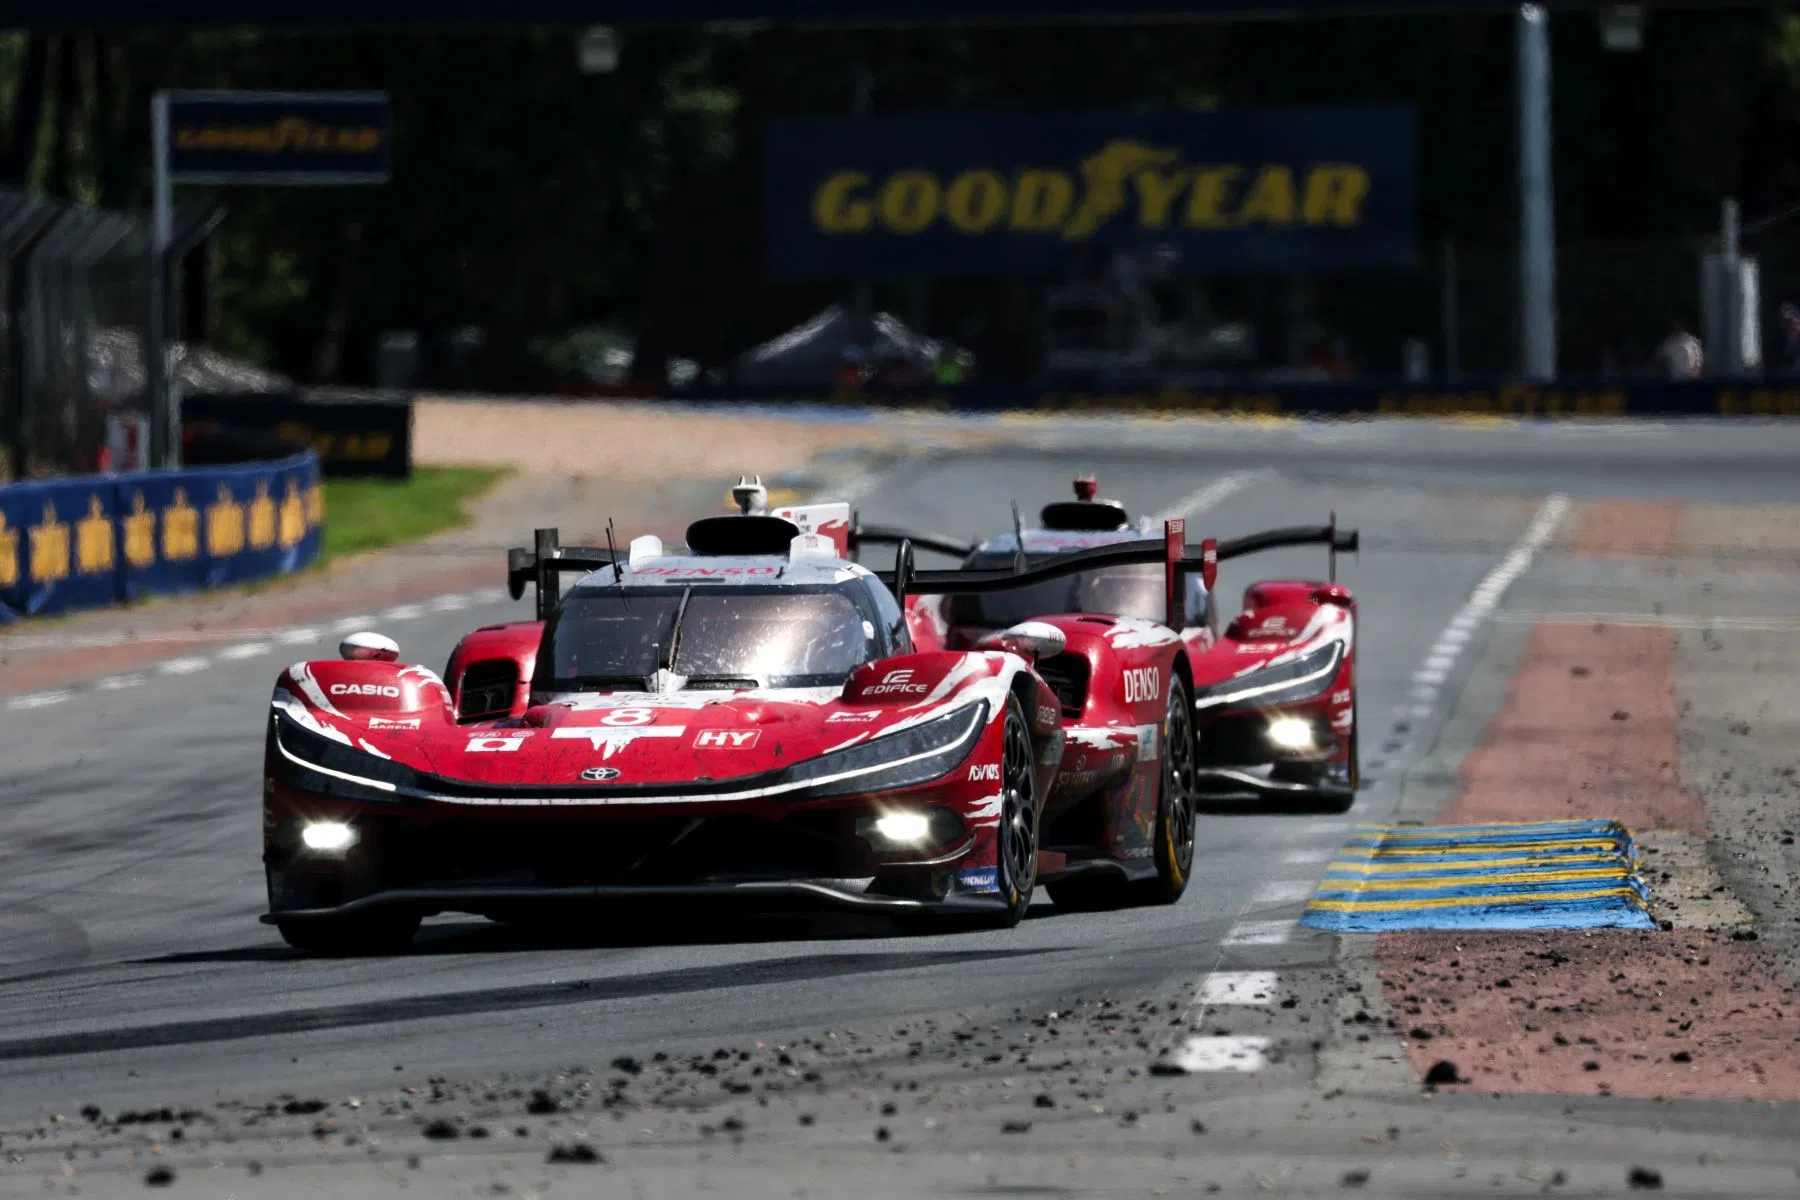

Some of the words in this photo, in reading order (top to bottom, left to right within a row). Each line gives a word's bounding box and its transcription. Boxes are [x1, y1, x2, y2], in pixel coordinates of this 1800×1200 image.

[811, 139, 1371, 241] GOODYEAR
[633, 566, 774, 576] DENSO
[330, 683, 400, 698] CASIO
[861, 682, 928, 696] EDIFICE
[1123, 666, 1160, 703] DENSO
[600, 707, 653, 726] 8
[697, 731, 757, 746] HY
